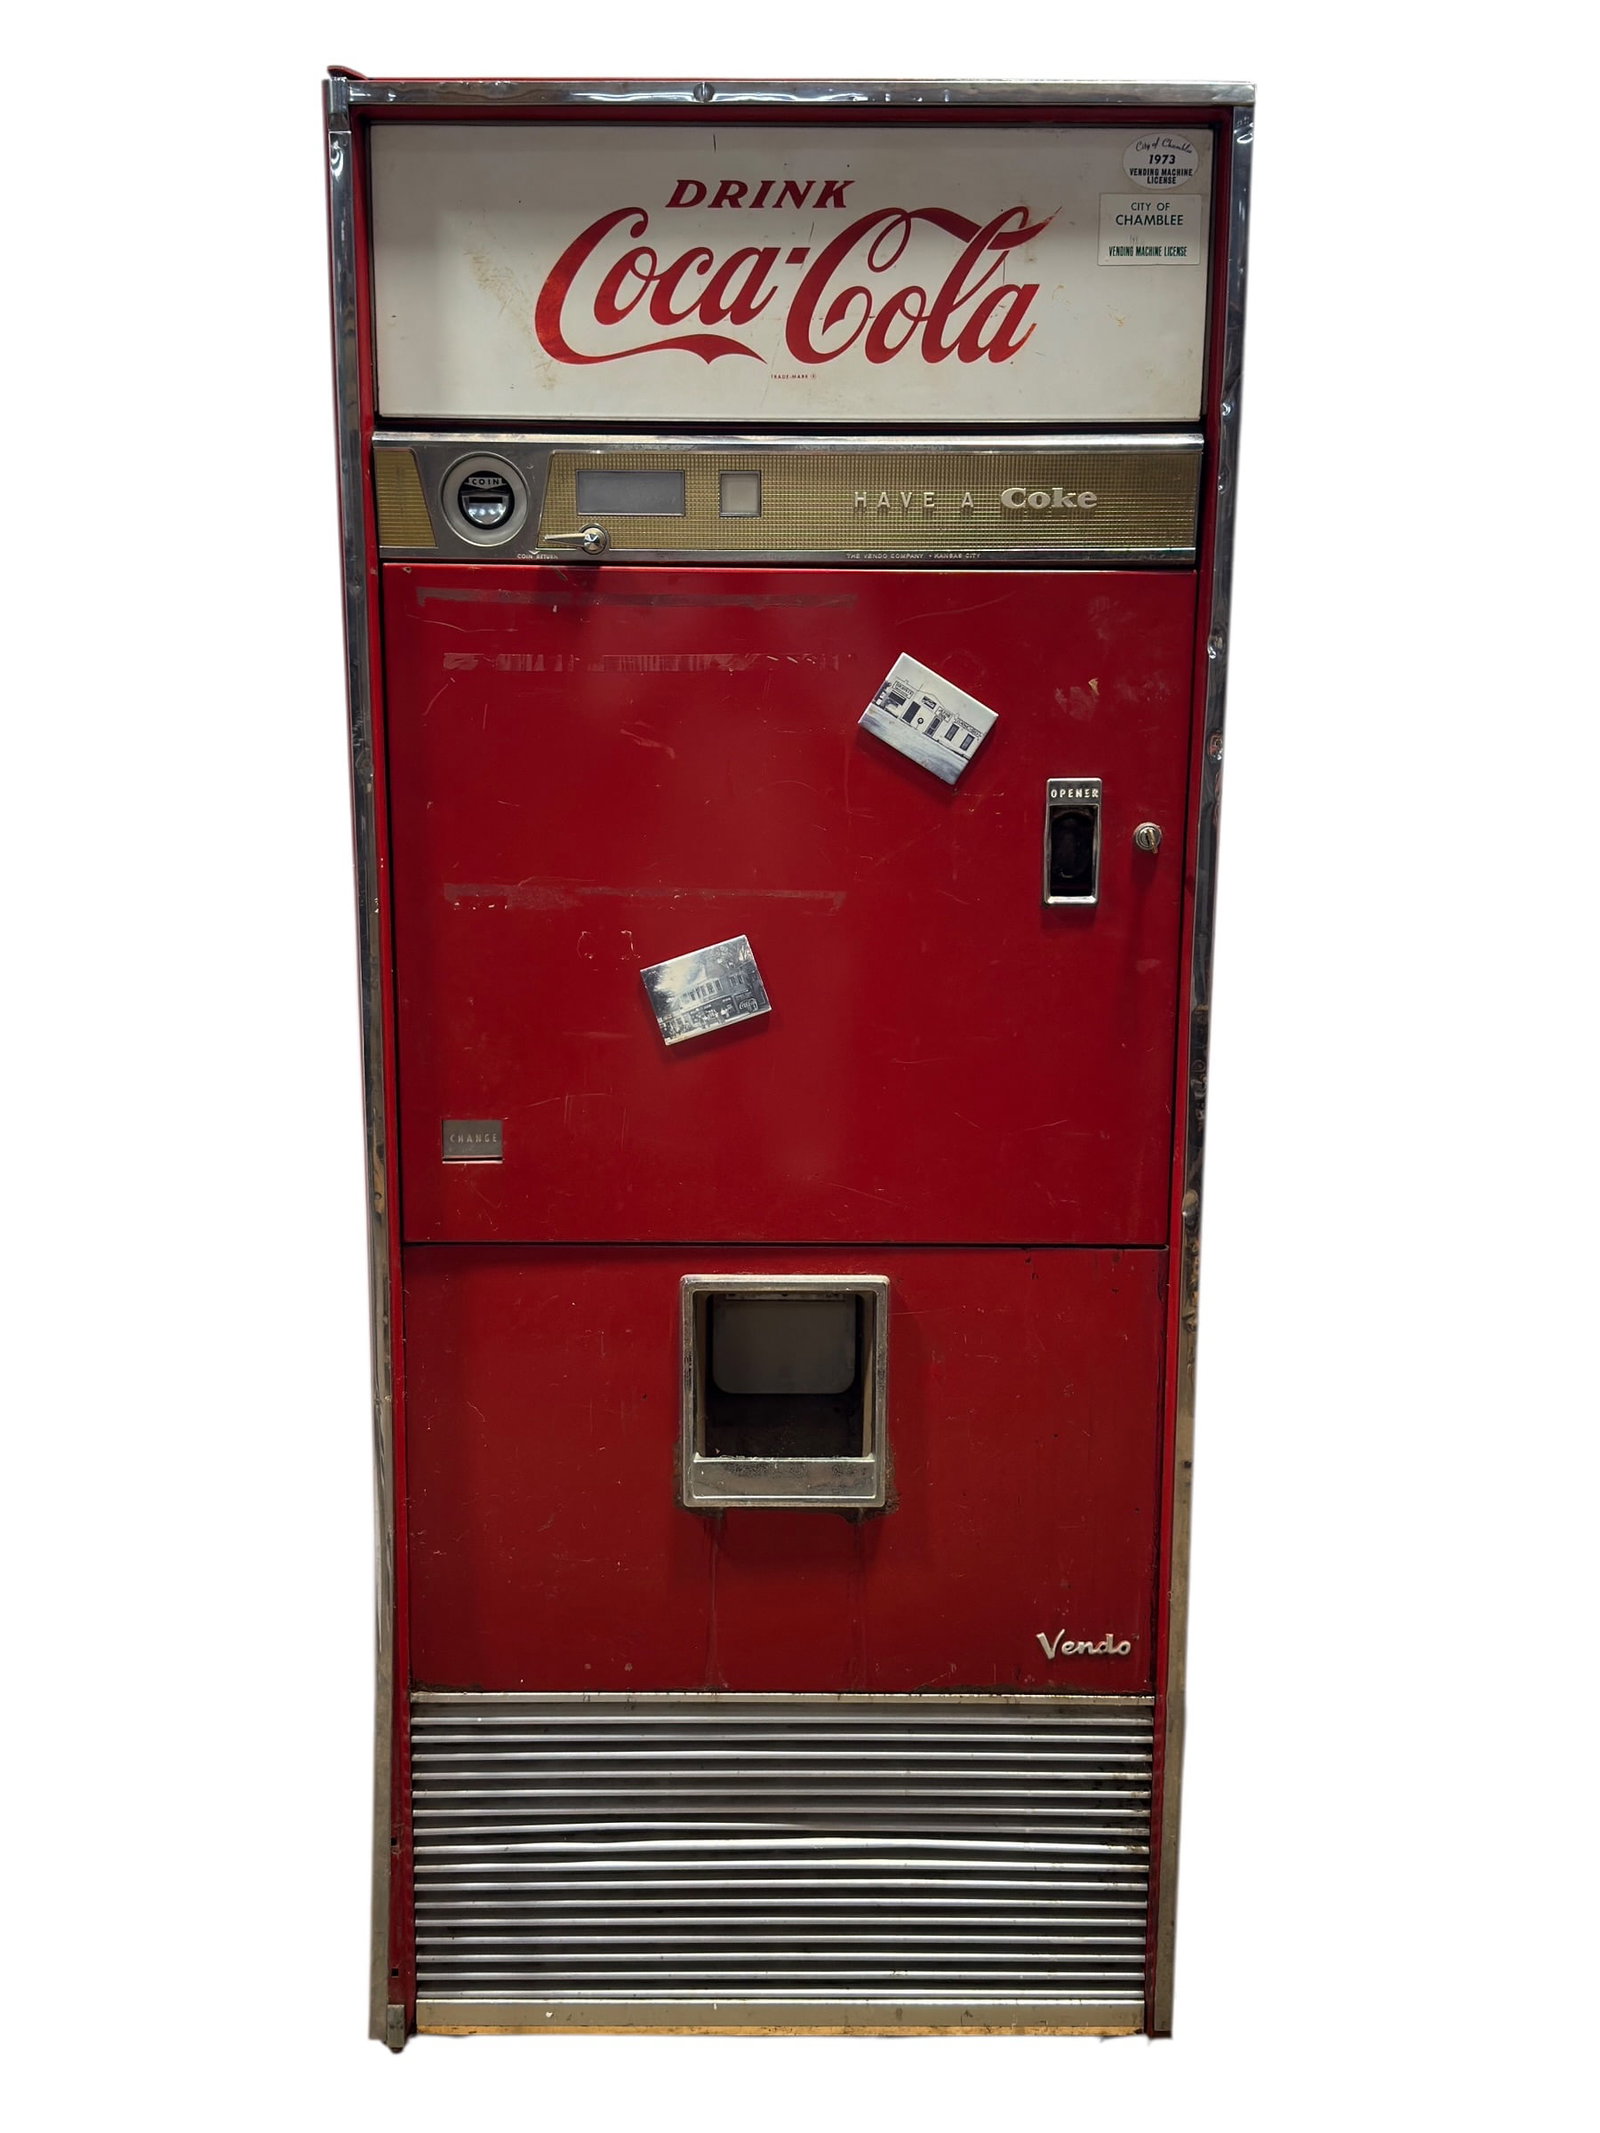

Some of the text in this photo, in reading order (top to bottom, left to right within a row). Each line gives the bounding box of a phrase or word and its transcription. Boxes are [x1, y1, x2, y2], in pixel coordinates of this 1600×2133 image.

[1149, 154, 1176, 164] 1973
[1129, 168, 1193, 176] VENDING MACHINE
[1146, 176, 1177, 185] LICENSE
[665, 179, 855, 209] DRINK
[1130, 202, 1171, 211] CITY OF
[1115, 214, 1184, 226] CHAMBLEE
[1108, 246, 1188, 257] VENDING MACHINE LICENSE
[534, 206, 1062, 366] Coca-Cola
[854, 487, 1098, 509] HAVE A Coke
[1050, 788, 1099, 798] OPENER
[449, 1133, 497, 1143] CHANGE
[1035, 1628, 1131, 1660] Vendo
